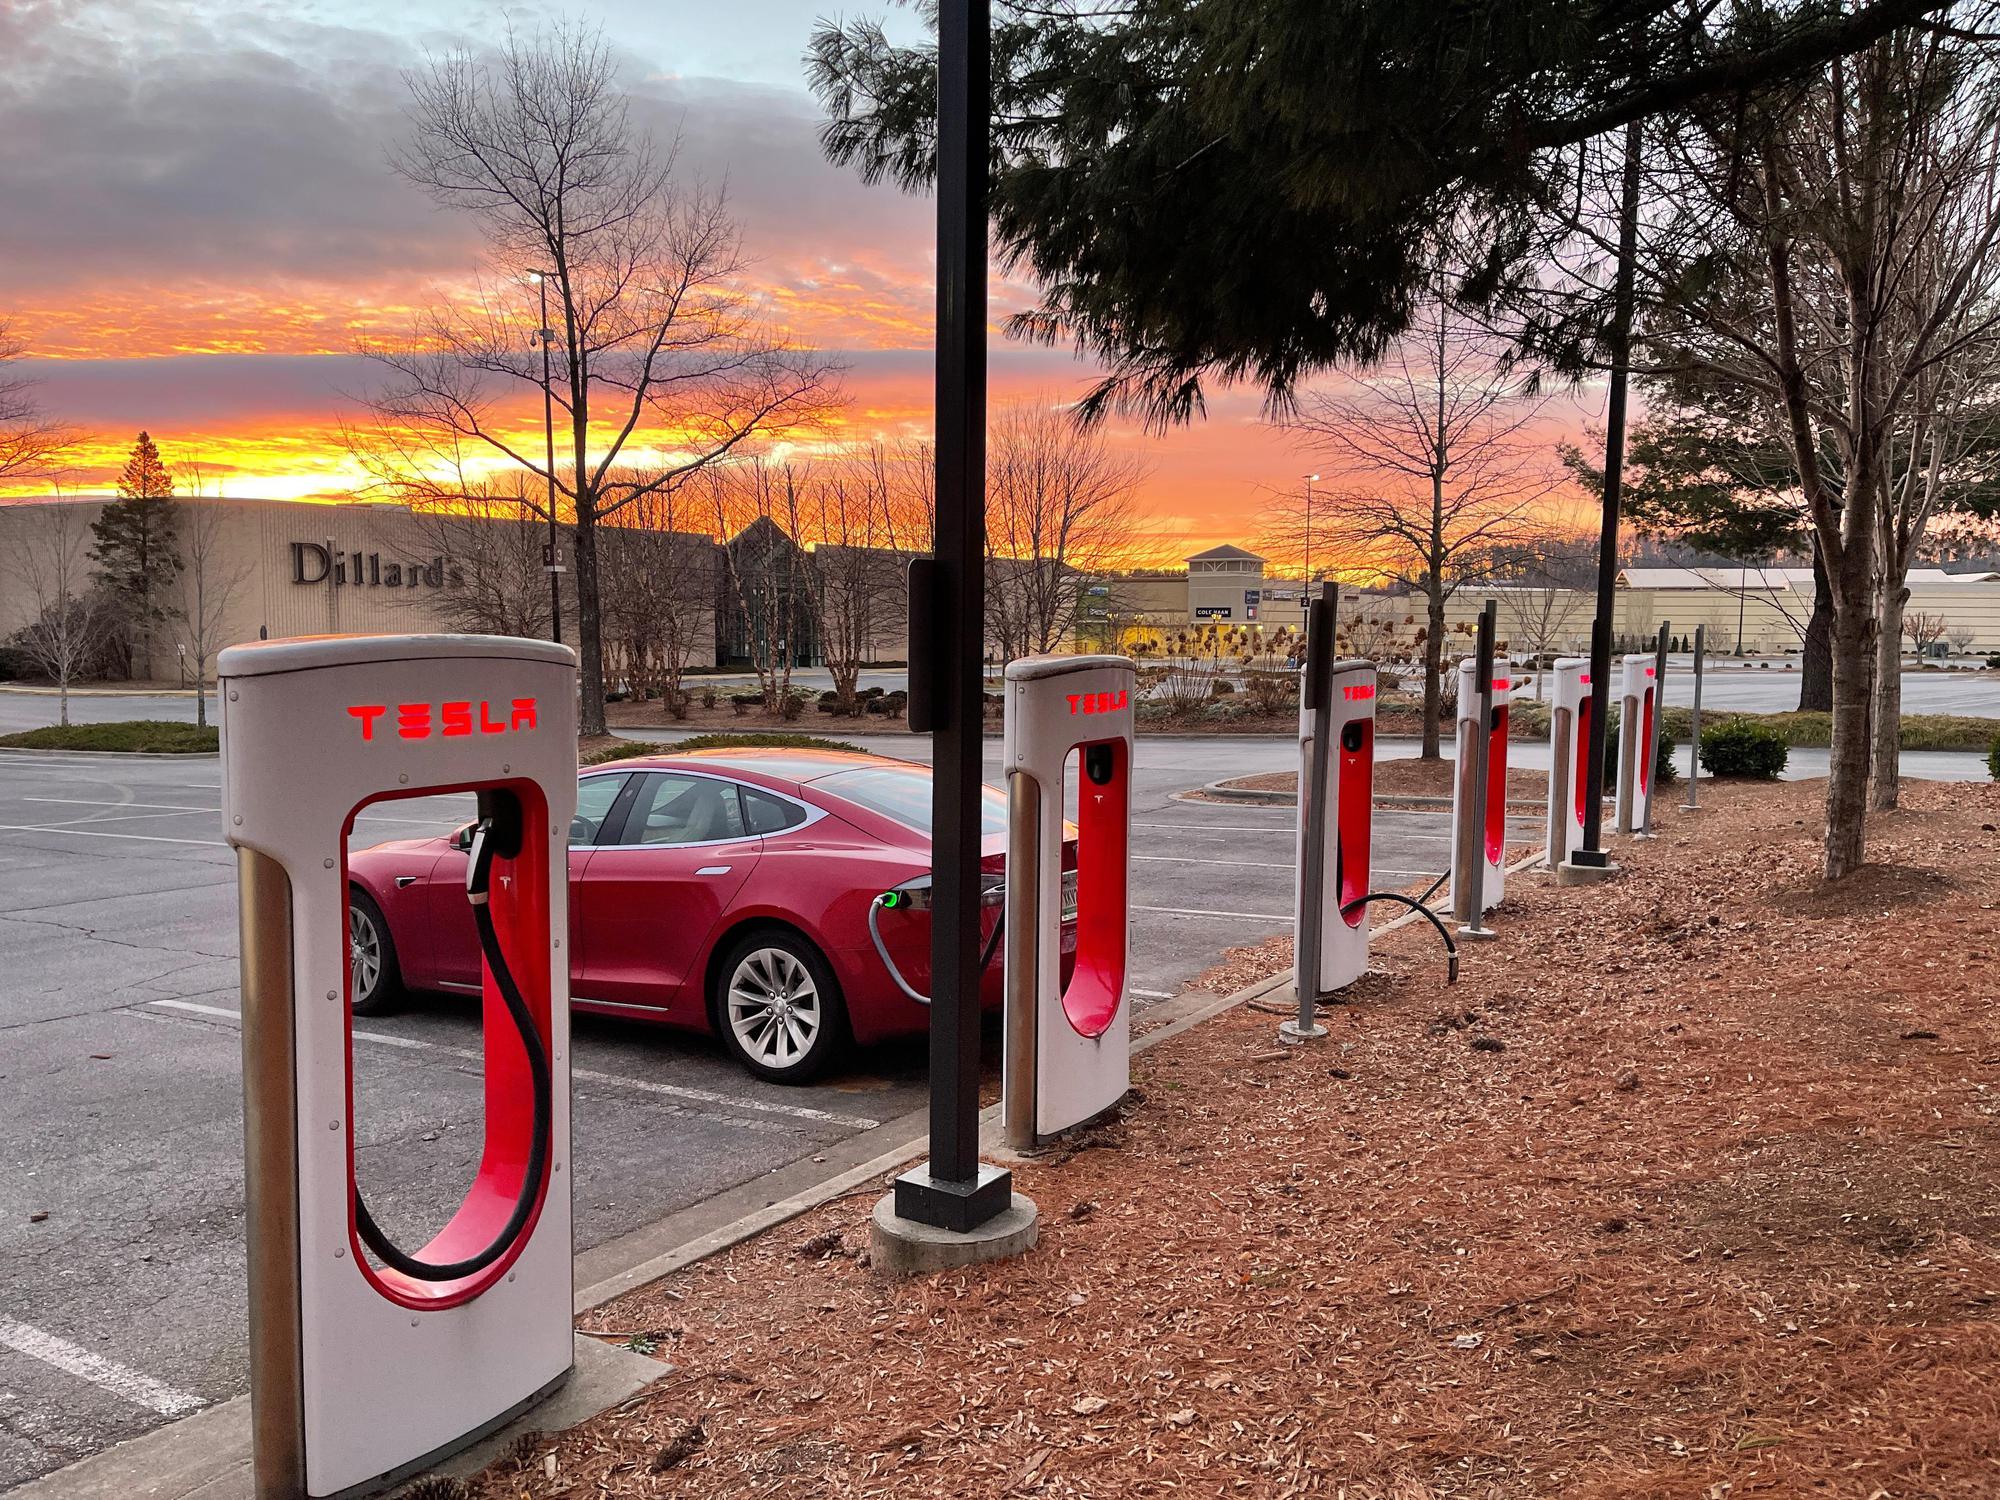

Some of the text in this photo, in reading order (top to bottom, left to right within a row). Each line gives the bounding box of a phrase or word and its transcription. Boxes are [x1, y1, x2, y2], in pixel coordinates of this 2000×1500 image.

[556, 548, 563, 562] 3
[1066, 689, 1129, 715] TESLA
[347, 697, 537, 741] TESLA
